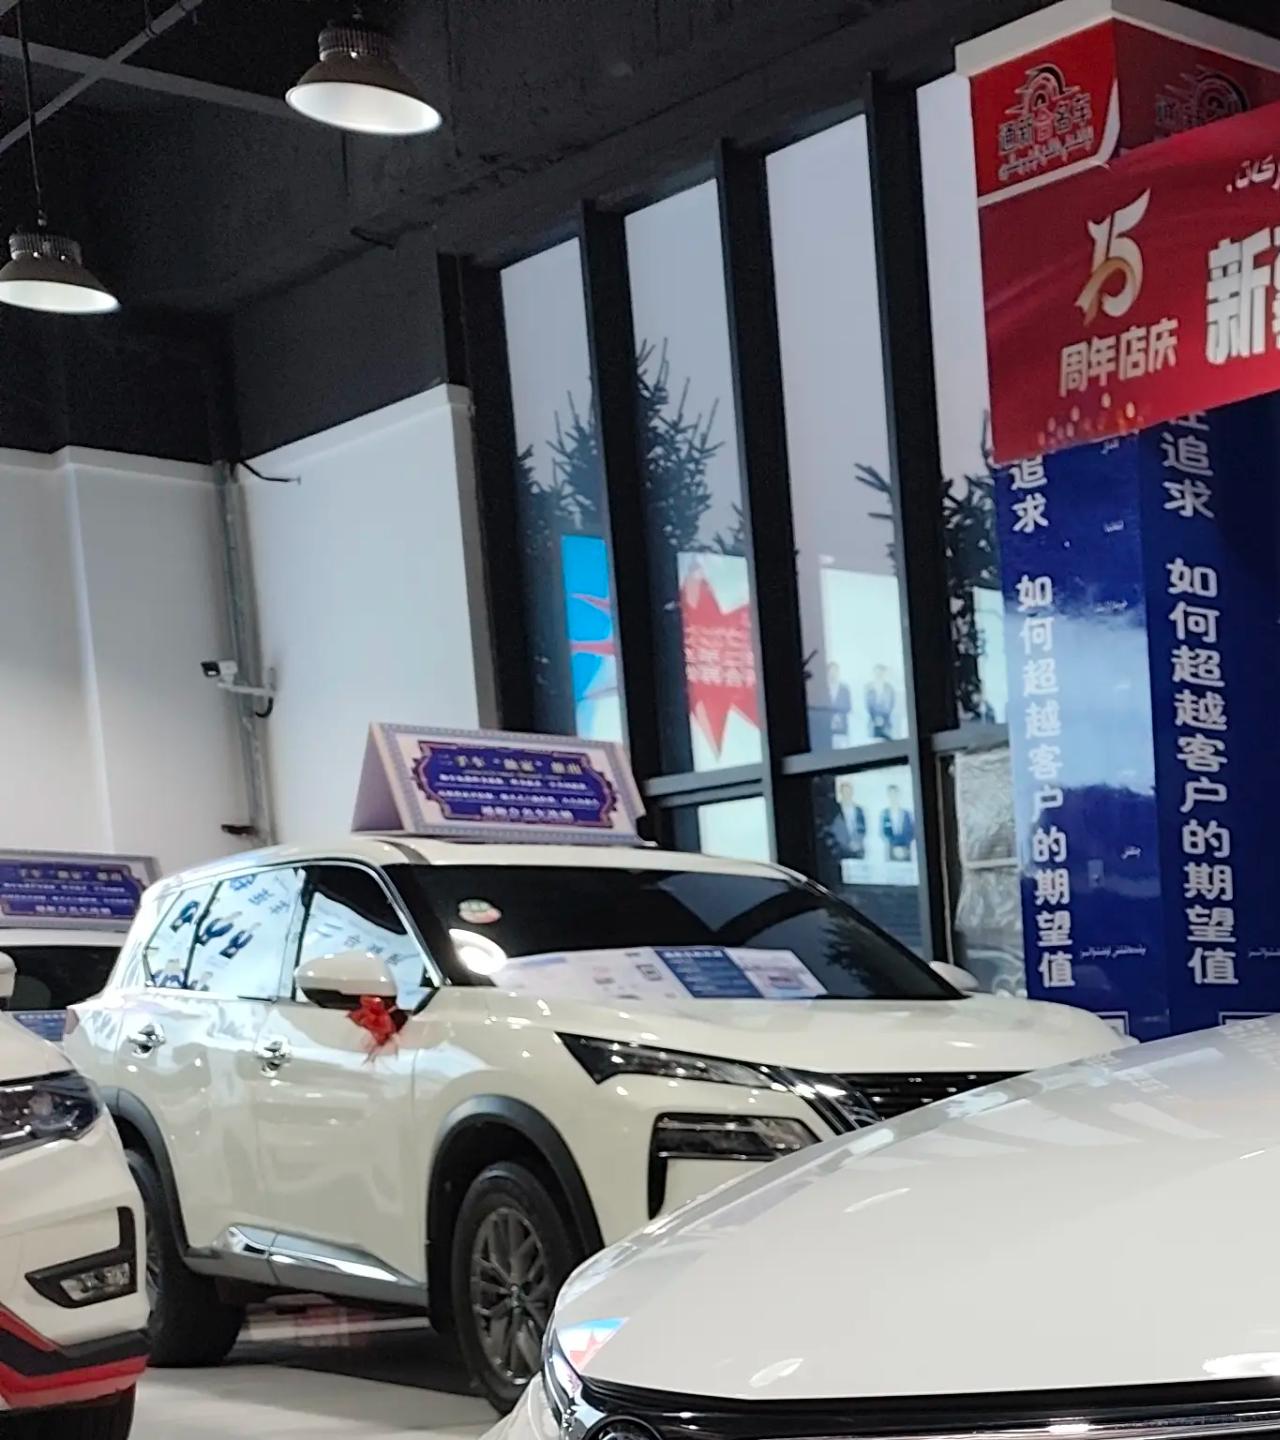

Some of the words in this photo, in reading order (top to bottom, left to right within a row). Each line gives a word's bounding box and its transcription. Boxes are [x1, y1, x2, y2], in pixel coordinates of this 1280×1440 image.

[1059, 316, 1179, 398] 周年店庆
[1016, 574, 1077, 989] 如何超越客户的期望值
[1165, 557, 1239, 986] 如何超越客户的期望值
